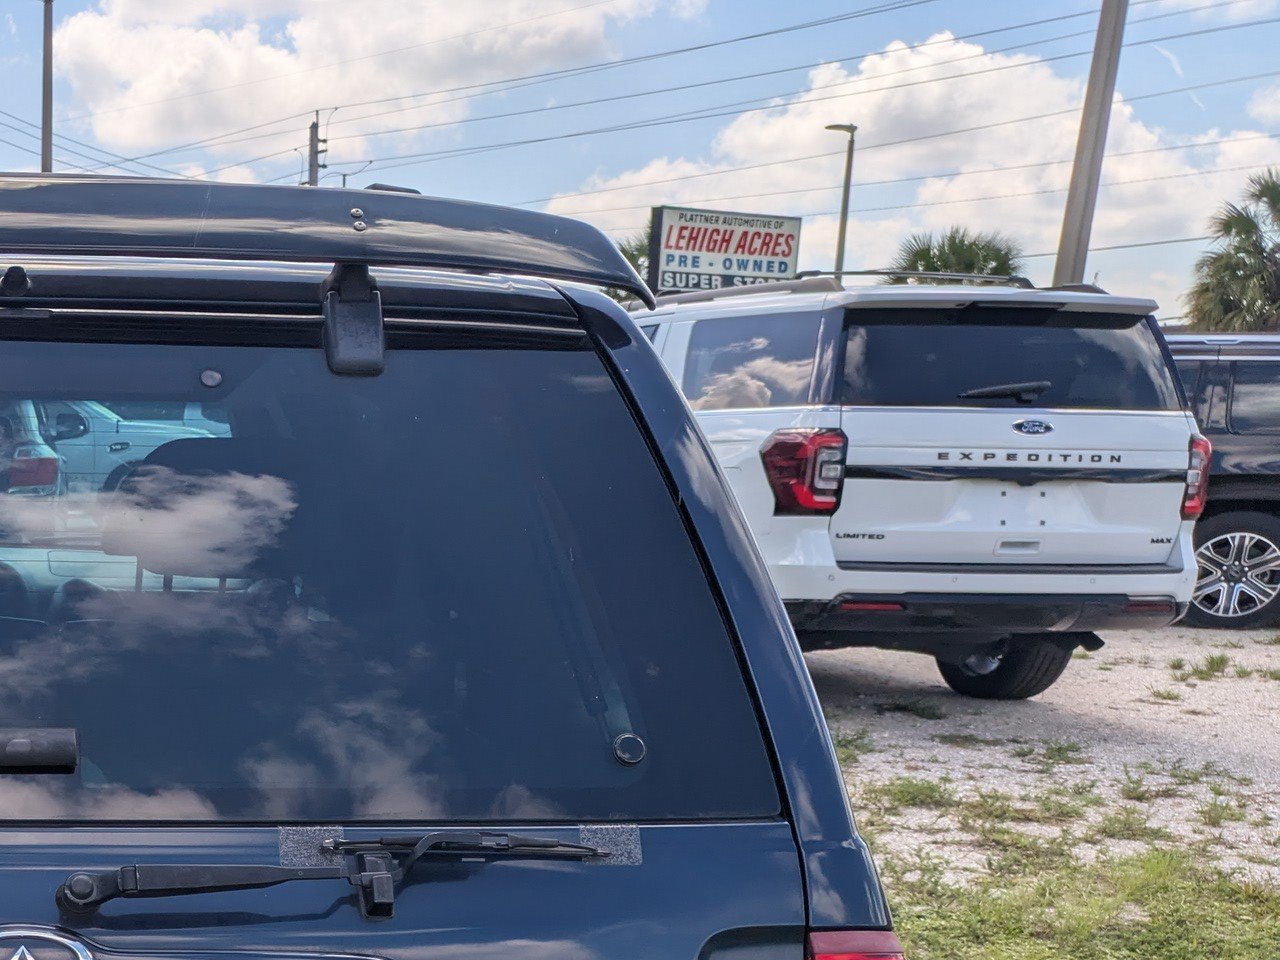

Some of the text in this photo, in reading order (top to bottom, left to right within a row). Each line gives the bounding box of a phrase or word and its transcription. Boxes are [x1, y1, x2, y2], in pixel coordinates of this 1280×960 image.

[678, 212, 784, 229] PLATTNER AUTOMOTIVE OF
[664, 225, 794, 258] LEHIGH ACRES
[722, 258, 788, 273] OWNED
[663, 272, 722, 289] SUPER
[1021, 421, 1046, 433] Ford
[937, 452, 1122, 463] EXPEDITION
[1150, 537, 1173, 545] MAX
